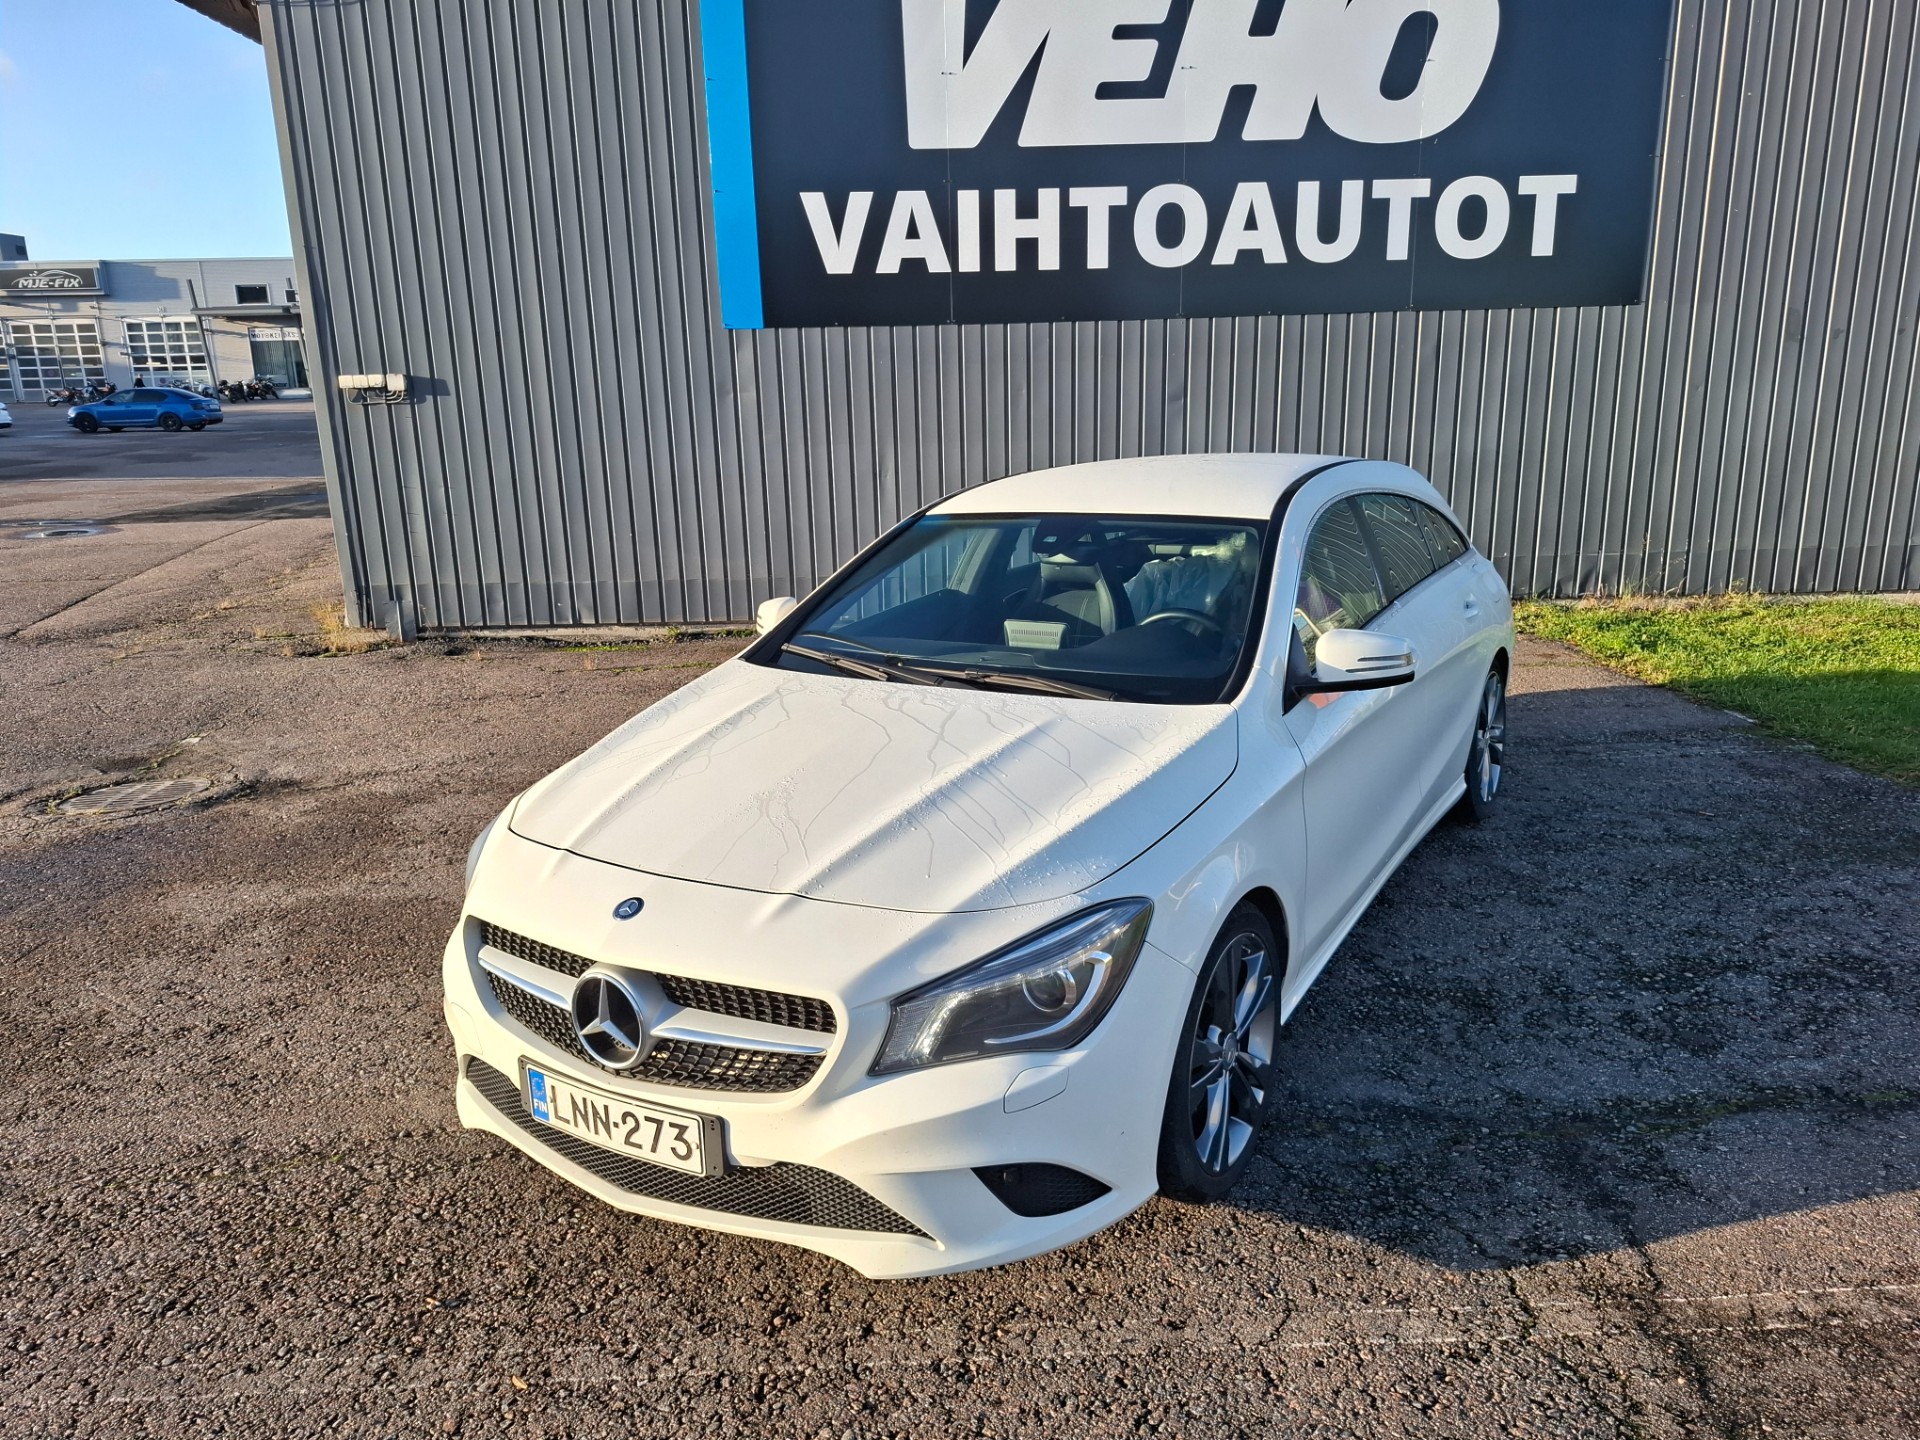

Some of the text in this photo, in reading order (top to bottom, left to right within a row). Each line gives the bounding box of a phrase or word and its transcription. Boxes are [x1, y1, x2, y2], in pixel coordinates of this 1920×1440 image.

[902, 0, 1501, 150] VEHO
[799, 173, 1578, 275] VAIHTOAUTOT
[18, 278, 79, 288] MJE-FIX
[533, 1098, 548, 1113] FIN
[550, 1085, 693, 1161] LNN-273
